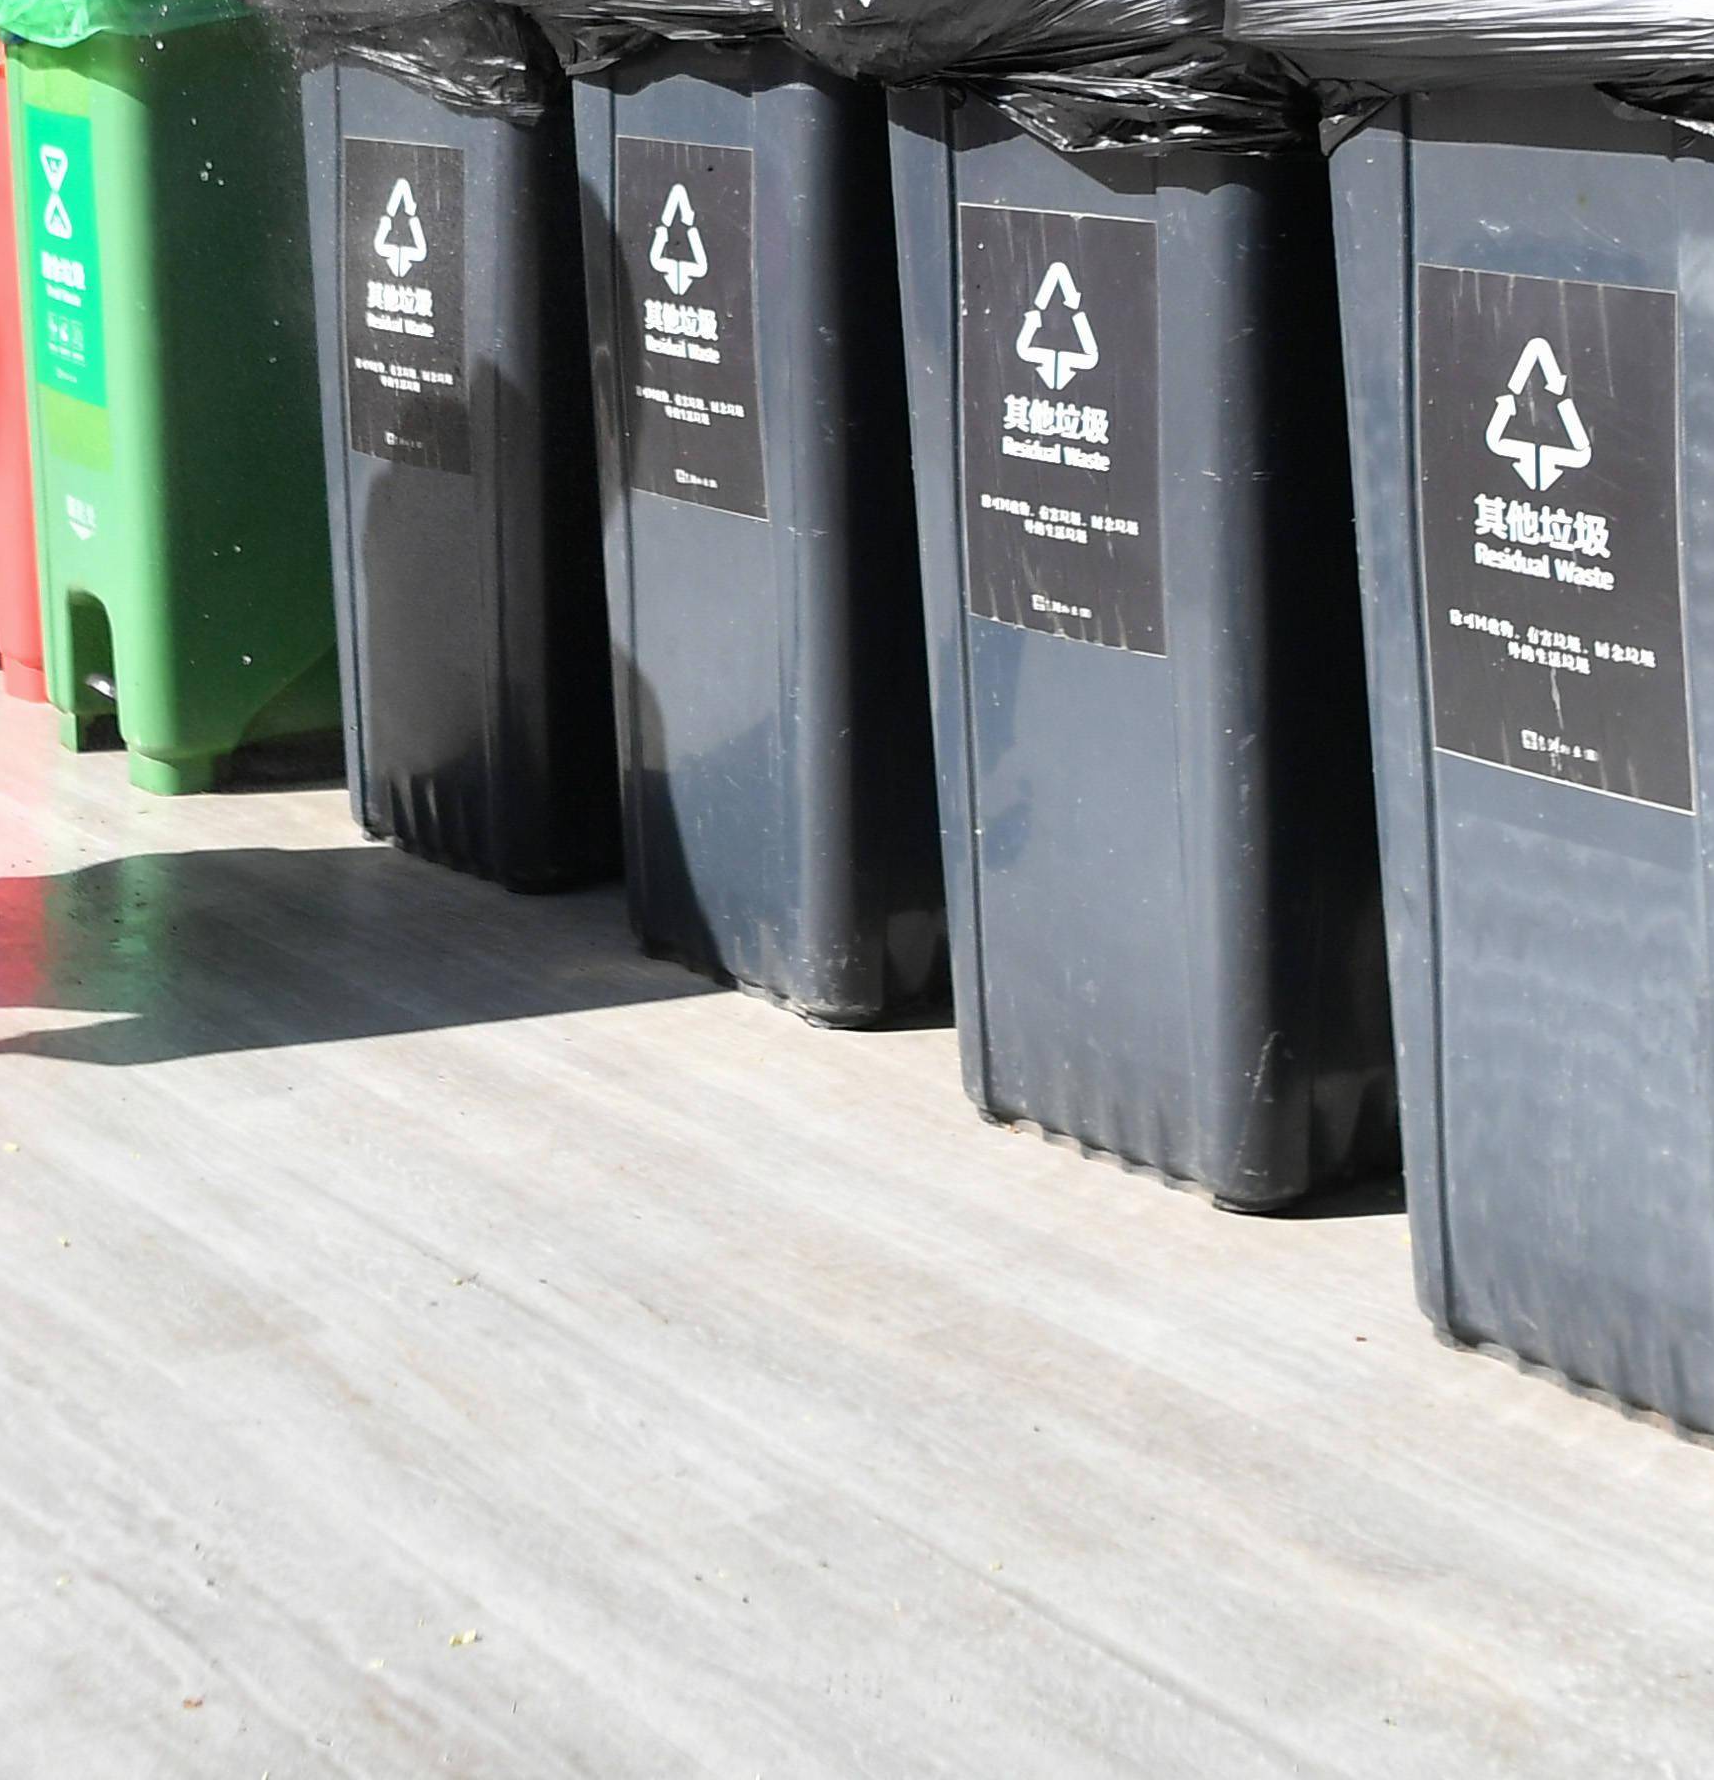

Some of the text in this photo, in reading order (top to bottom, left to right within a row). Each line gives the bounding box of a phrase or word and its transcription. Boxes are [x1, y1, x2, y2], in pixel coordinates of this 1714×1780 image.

[367, 281, 433, 317] 其他垃圾
[644, 298, 719, 340] 其他垃圾
[1003, 394, 1109, 445] 其他垃圾
[1002, 436, 1111, 473] Residual Waste
[1473, 493, 1611, 560] 其他垃圾
[1474, 542, 1614, 591] Residual Waste
